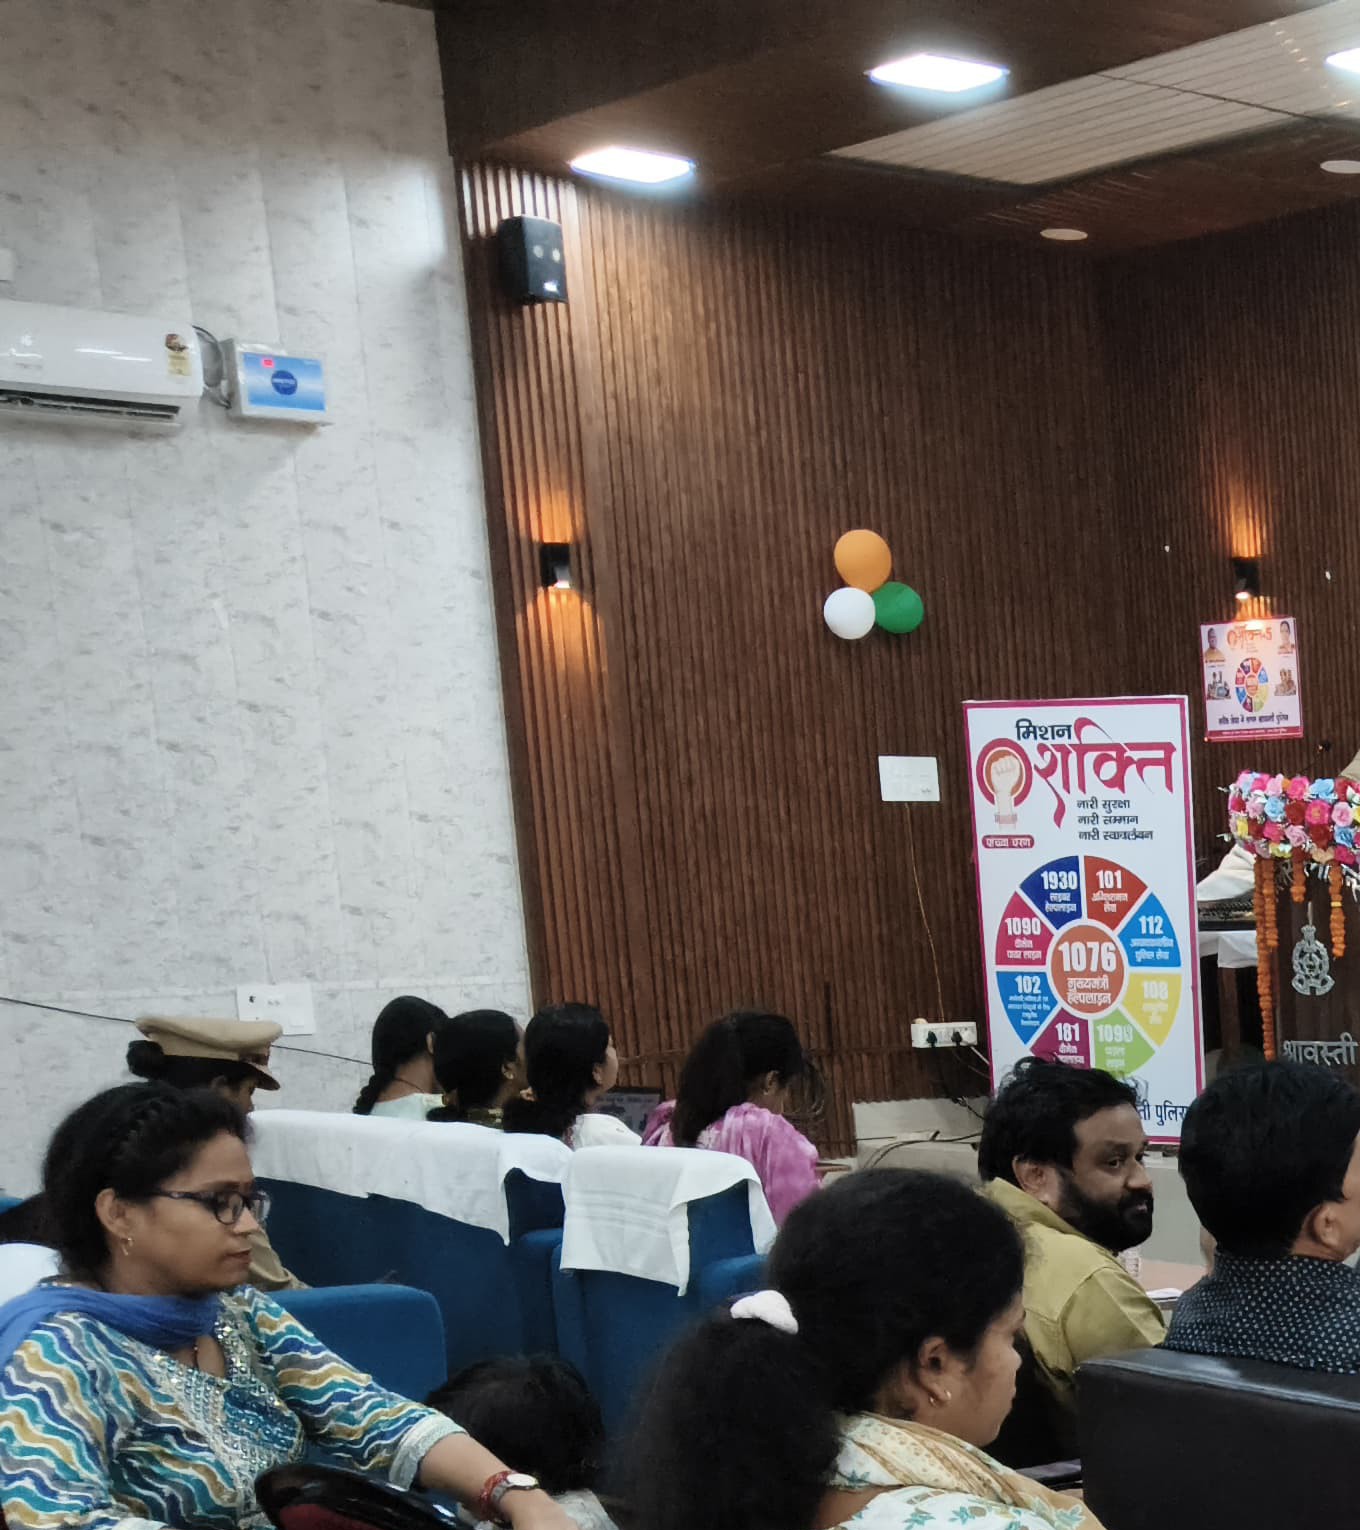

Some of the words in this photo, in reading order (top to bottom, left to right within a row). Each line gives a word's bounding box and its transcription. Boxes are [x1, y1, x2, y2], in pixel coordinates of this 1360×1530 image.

[1015, 718, 1073, 741] मिशन
[1034, 717, 1177, 829] शक्ति
[1077, 796, 1099, 809] नारी
[1101, 799, 1131, 815] सुरक्षा
[1077, 812, 1099, 825] नारी
[1102, 814, 1139, 826] सम्मान
[1078, 828, 1100, 841] नारी
[1040, 870, 1078, 890] 1930
[1096, 869, 1123, 889] 101
[1004, 917, 1042, 936] 1090
[1138, 915, 1164, 935] 112
[1058, 941, 1118, 974] 1076
[1014, 975, 1043, 994] 102
[1055, 1022, 1081, 1042] 181
[1282, 1031, 1360, 1067] श्रावस्ती
